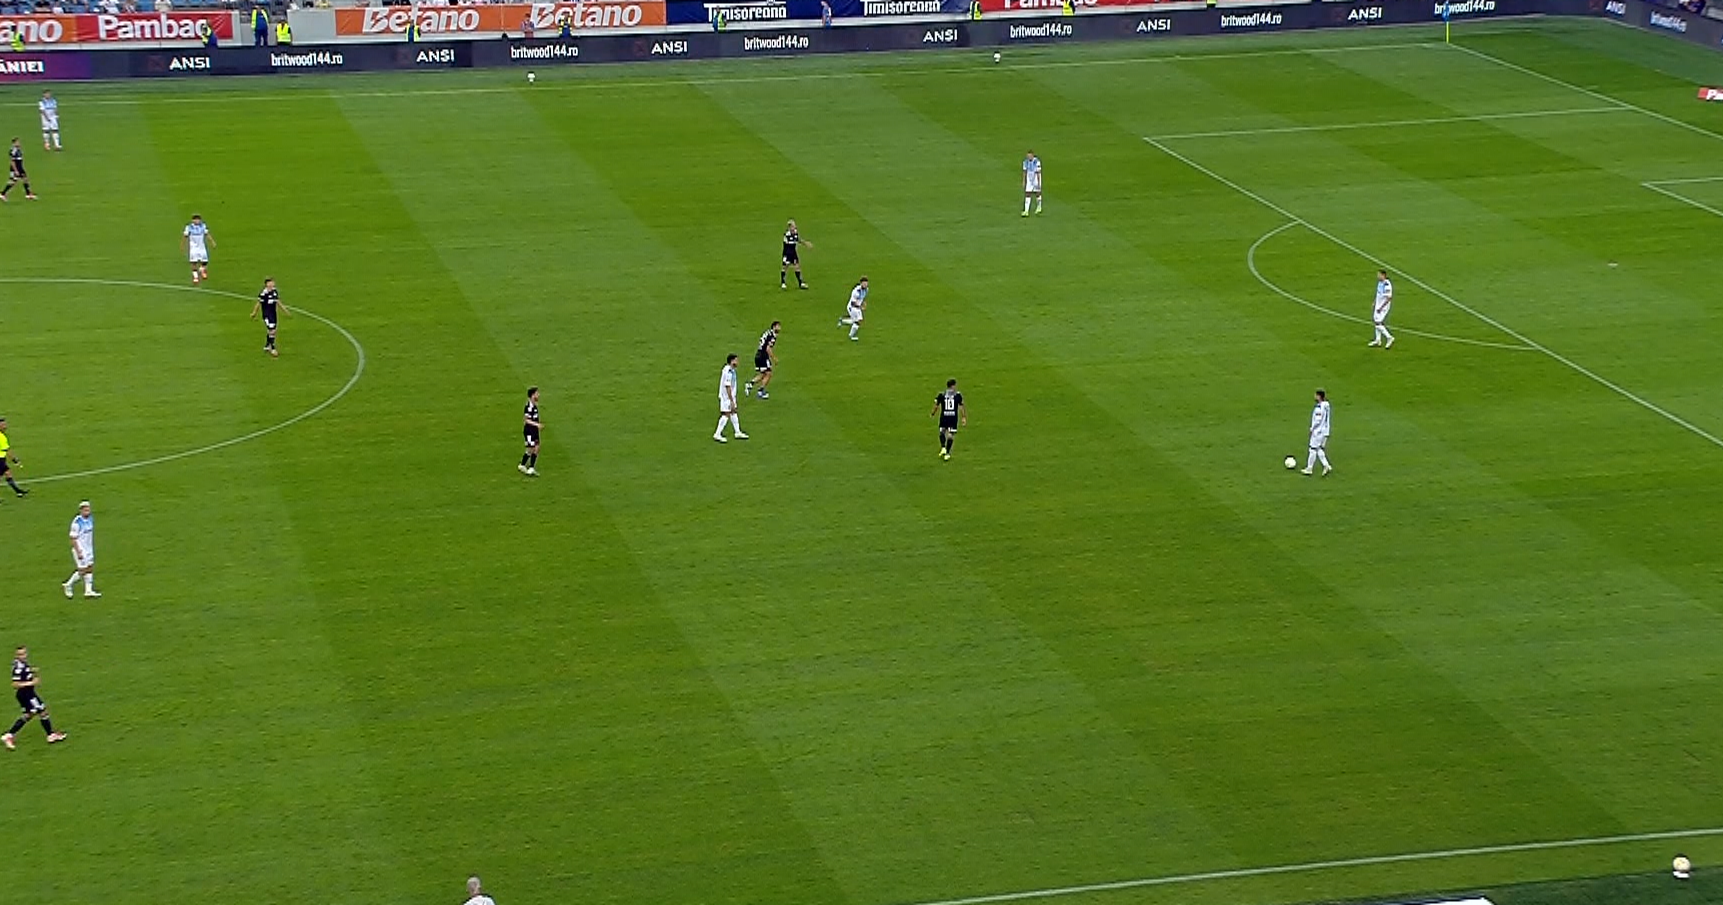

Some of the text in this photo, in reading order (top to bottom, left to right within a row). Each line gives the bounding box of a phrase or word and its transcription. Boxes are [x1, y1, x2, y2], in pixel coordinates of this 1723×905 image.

[1347, 7, 1383, 20] ANSI
[1434, 0, 1495, 15] briwood144.ro
[362, 7, 479, 33] Betano
[1136, 19, 1171, 32] ANSI
[1220, 12, 1282, 28] britwood144.ro
[923, 29, 958, 42] ANSI
[1010, 23, 1072, 38] britwood144.ro
[651, 41, 688, 55] ANSI
[744, 35, 809, 50] britwood144.ro
[271, 51, 343, 66] britwood144.ro
[416, 49, 455, 62] ANSI
[510, 45, 579, 59] britwood144.ro
[169, 57, 211, 70] ANSI
[944, 398, 955, 410] 10
